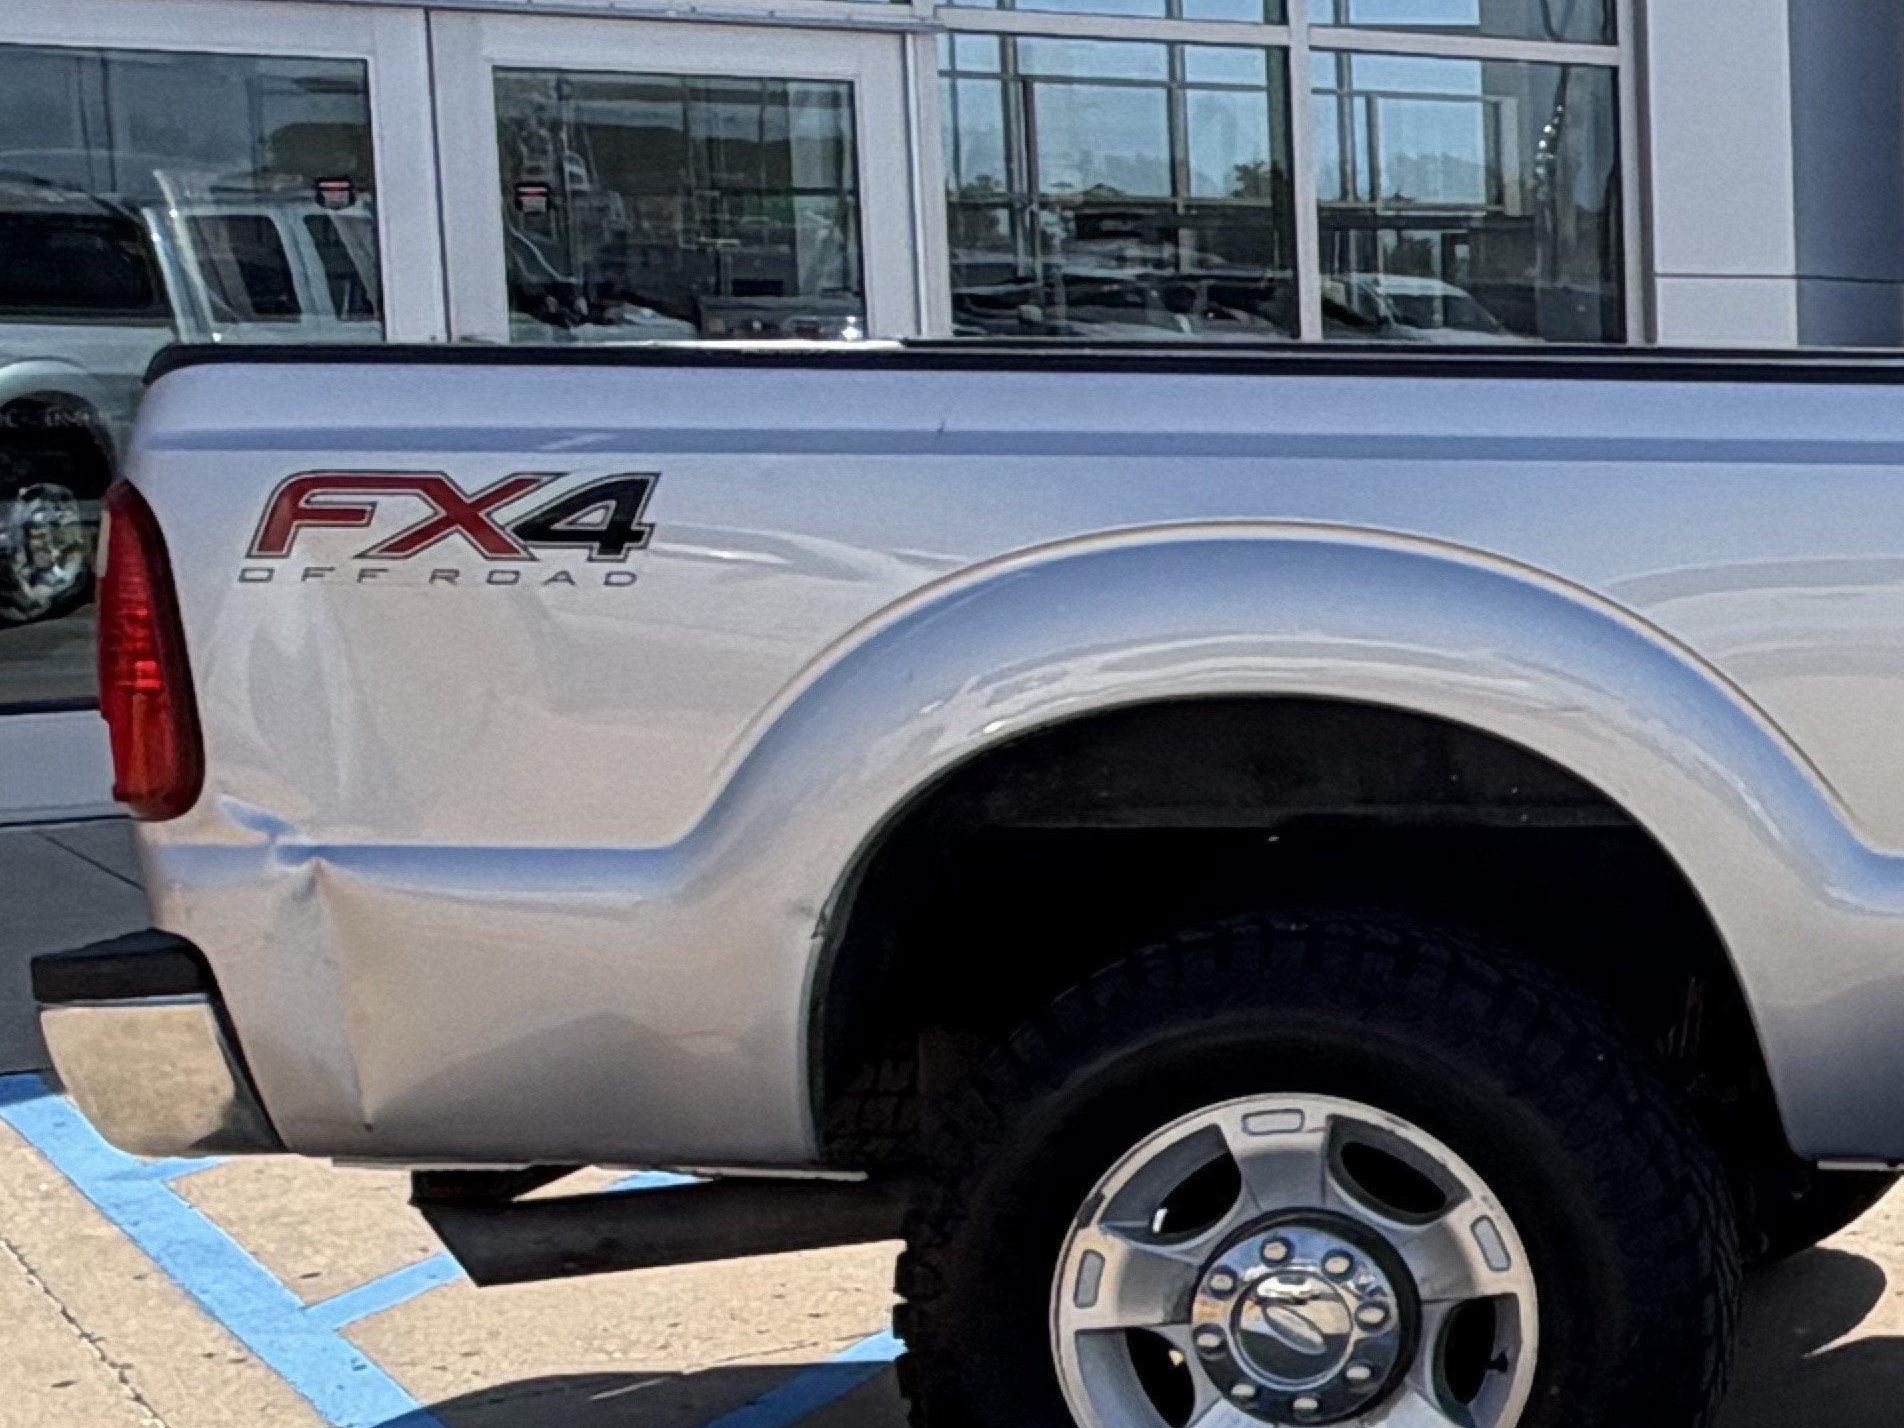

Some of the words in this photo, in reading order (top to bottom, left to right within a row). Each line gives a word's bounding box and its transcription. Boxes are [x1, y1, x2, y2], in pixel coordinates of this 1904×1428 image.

[244, 469, 662, 563] FX4
[237, 566, 389, 584] OFF
[427, 568, 639, 587] ROAD
